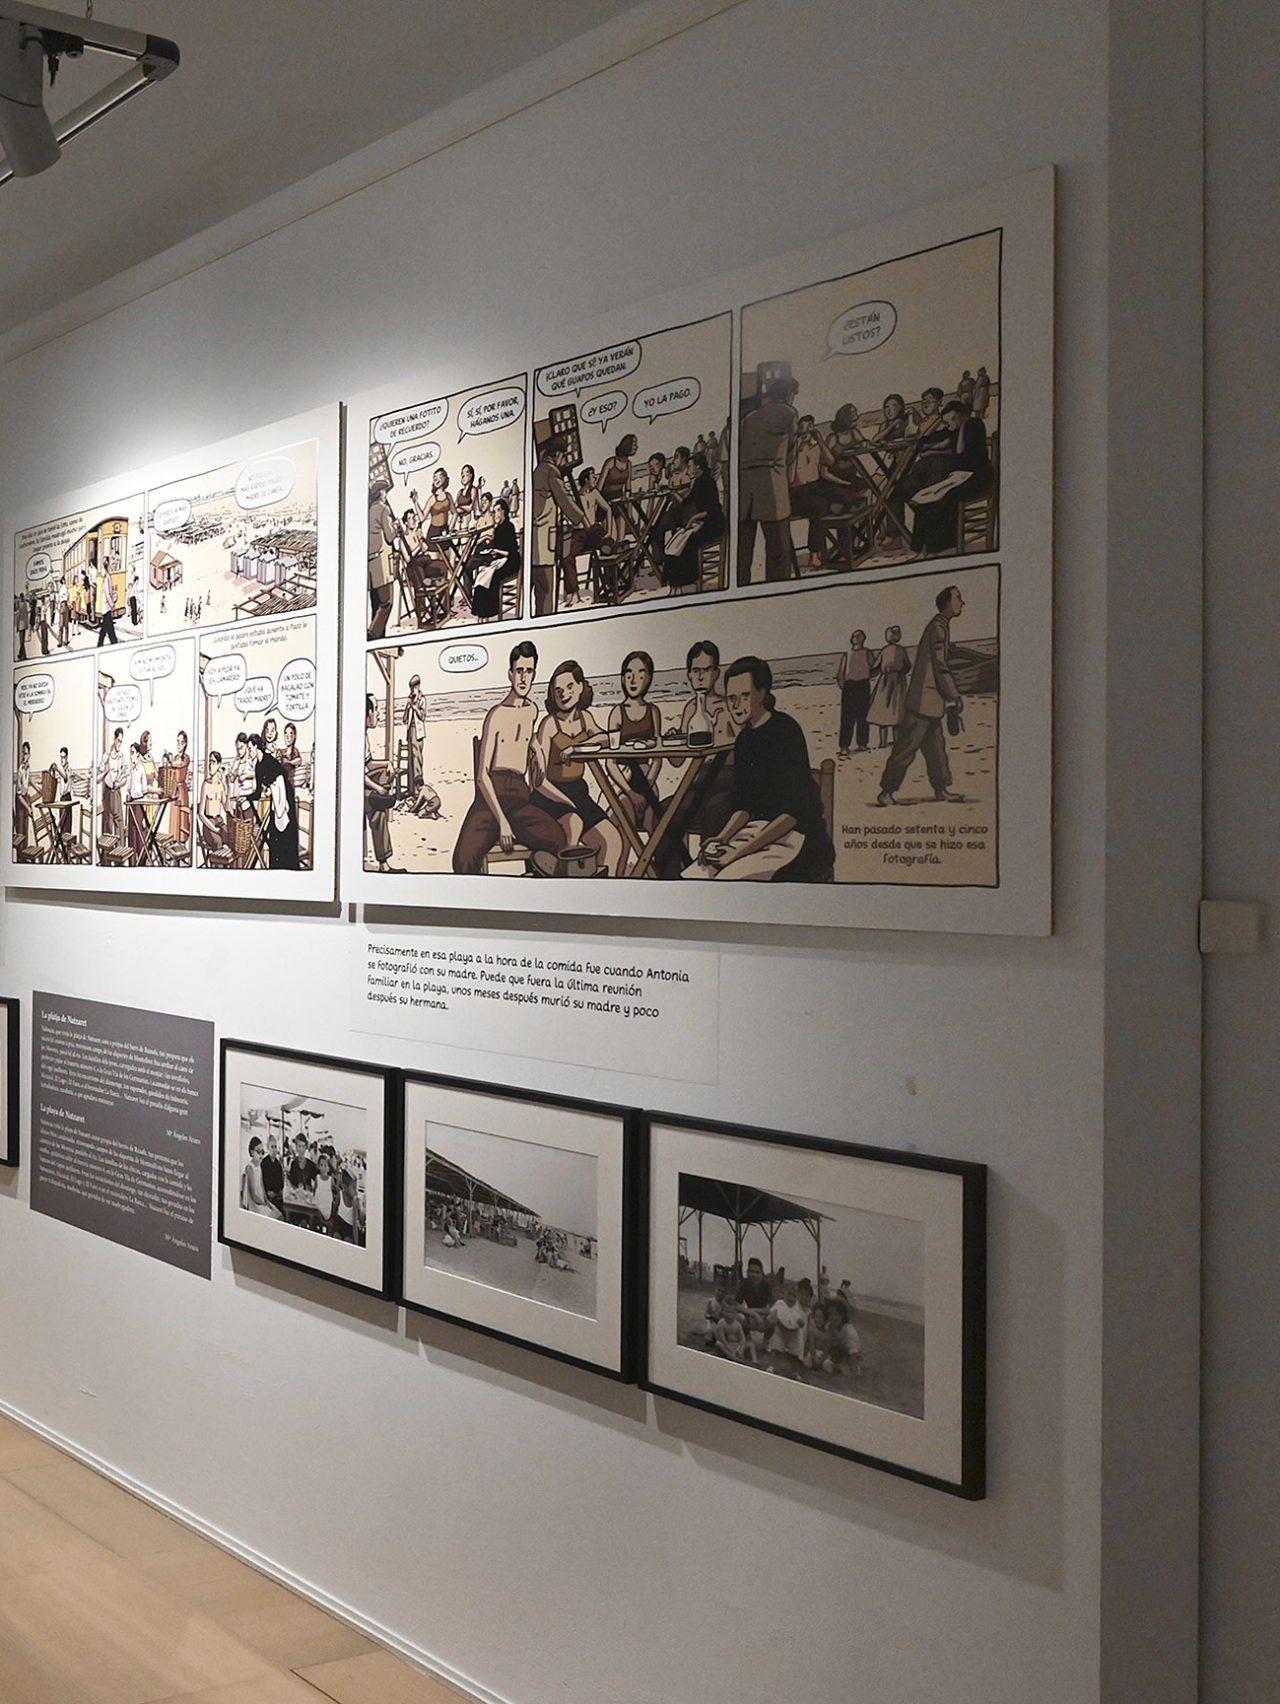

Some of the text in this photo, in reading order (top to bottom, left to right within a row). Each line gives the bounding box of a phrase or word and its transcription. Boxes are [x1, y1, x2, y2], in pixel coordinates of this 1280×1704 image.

[572, 363, 586, 373] QUE
[597, 355, 609, 365] YA
[610, 346, 634, 362] VERÁN
[567, 372, 594, 386] GUAPOS
[643, 388, 691, 408] YO LA PAGO.
[407, 414, 419, 423] UNA
[419, 405, 442, 418] FOTITO
[483, 403, 496, 414] POR
[599, 401, 618, 414] ESO?
[390, 420, 430, 438] DE RECUERDO?
[470, 412, 500, 428] HÁGANOS
[842, 824, 988, 837] Han pasado setenta y cinco
[844, 839, 985, 852] años desde que se hizo esa
[883, 853, 942, 867] fotografía.
[368, 944, 690, 983] Precisamente en esa playa a la hora de la comida fue cuando Antonia
[368, 960, 642, 997] se fotografió con su madre. Puede que fuera la última reunión
[367, 975, 660, 1018] familiar en la playa, unos meses después murió su madre y poco
[367, 990, 448, 1010] después su hermana.
